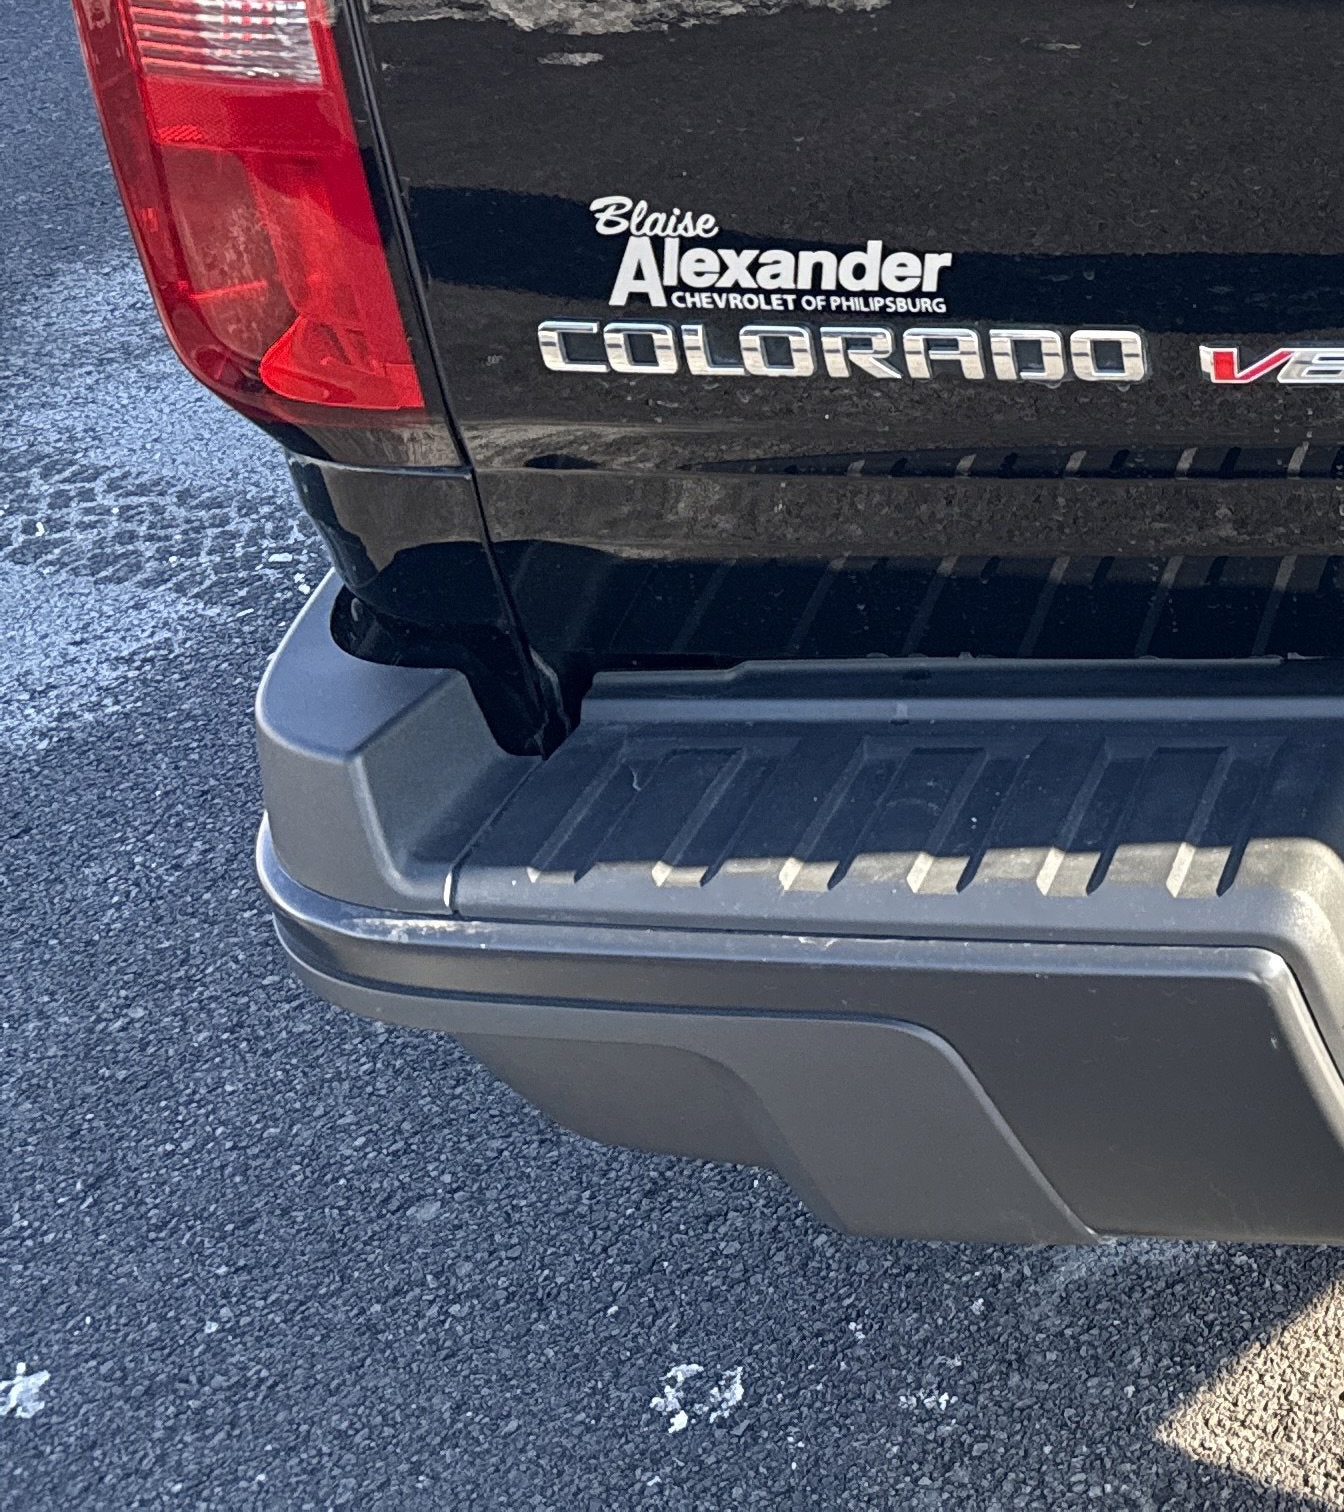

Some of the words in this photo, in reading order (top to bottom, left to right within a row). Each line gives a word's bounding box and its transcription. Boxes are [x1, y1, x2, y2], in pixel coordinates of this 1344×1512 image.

[589, 195, 719, 238] Blaise
[608, 236, 953, 307] Alexander
[671, 291, 795, 311] CHEVROLET
[800, 296, 829, 311] OF
[829, 296, 948, 314] PHILIPSBURG
[537, 319, 1147, 382] COLORADO
